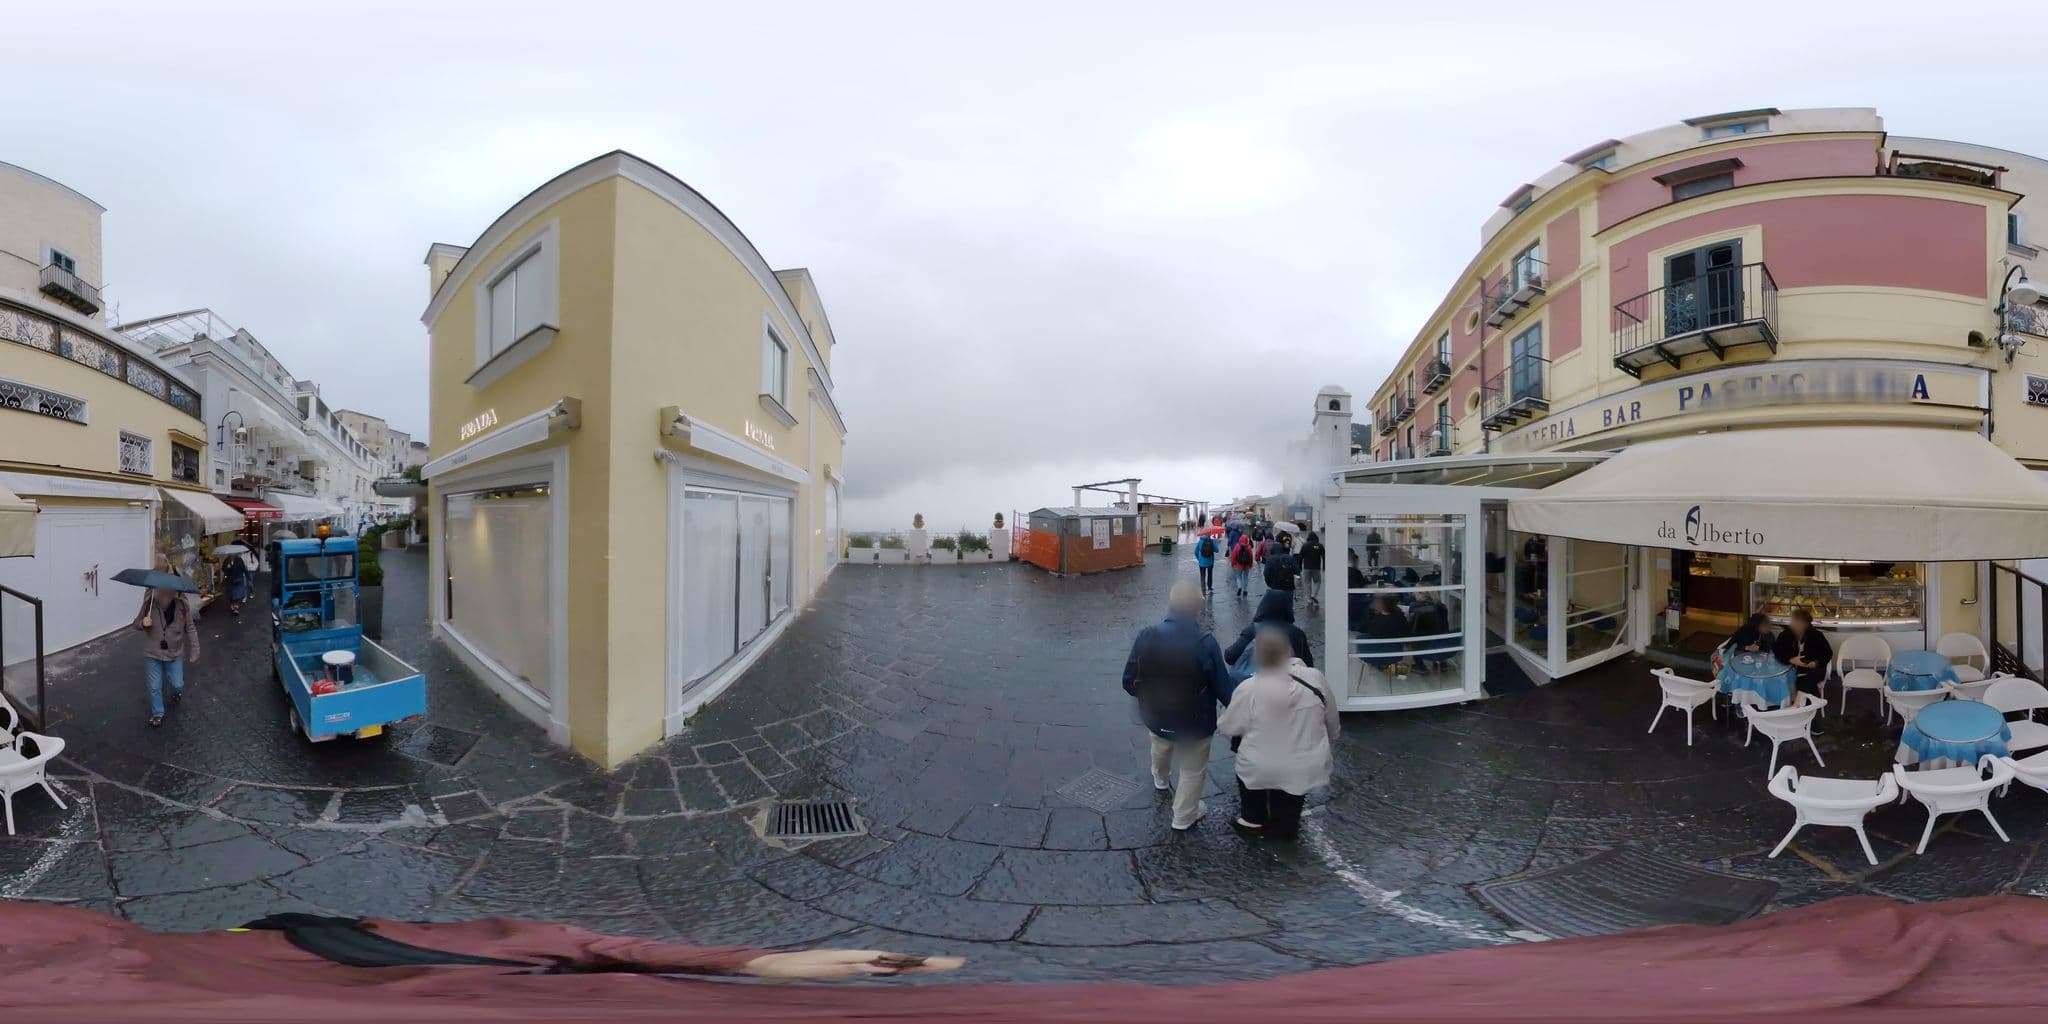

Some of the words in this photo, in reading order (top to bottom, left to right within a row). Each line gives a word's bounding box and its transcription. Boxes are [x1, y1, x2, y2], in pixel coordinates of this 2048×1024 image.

[460, 408, 498, 440] PRADA
[1603, 401, 1641, 427] BAR
[1657, 521, 1677, 539] da
[1685, 505, 1764, 545] Alberto
